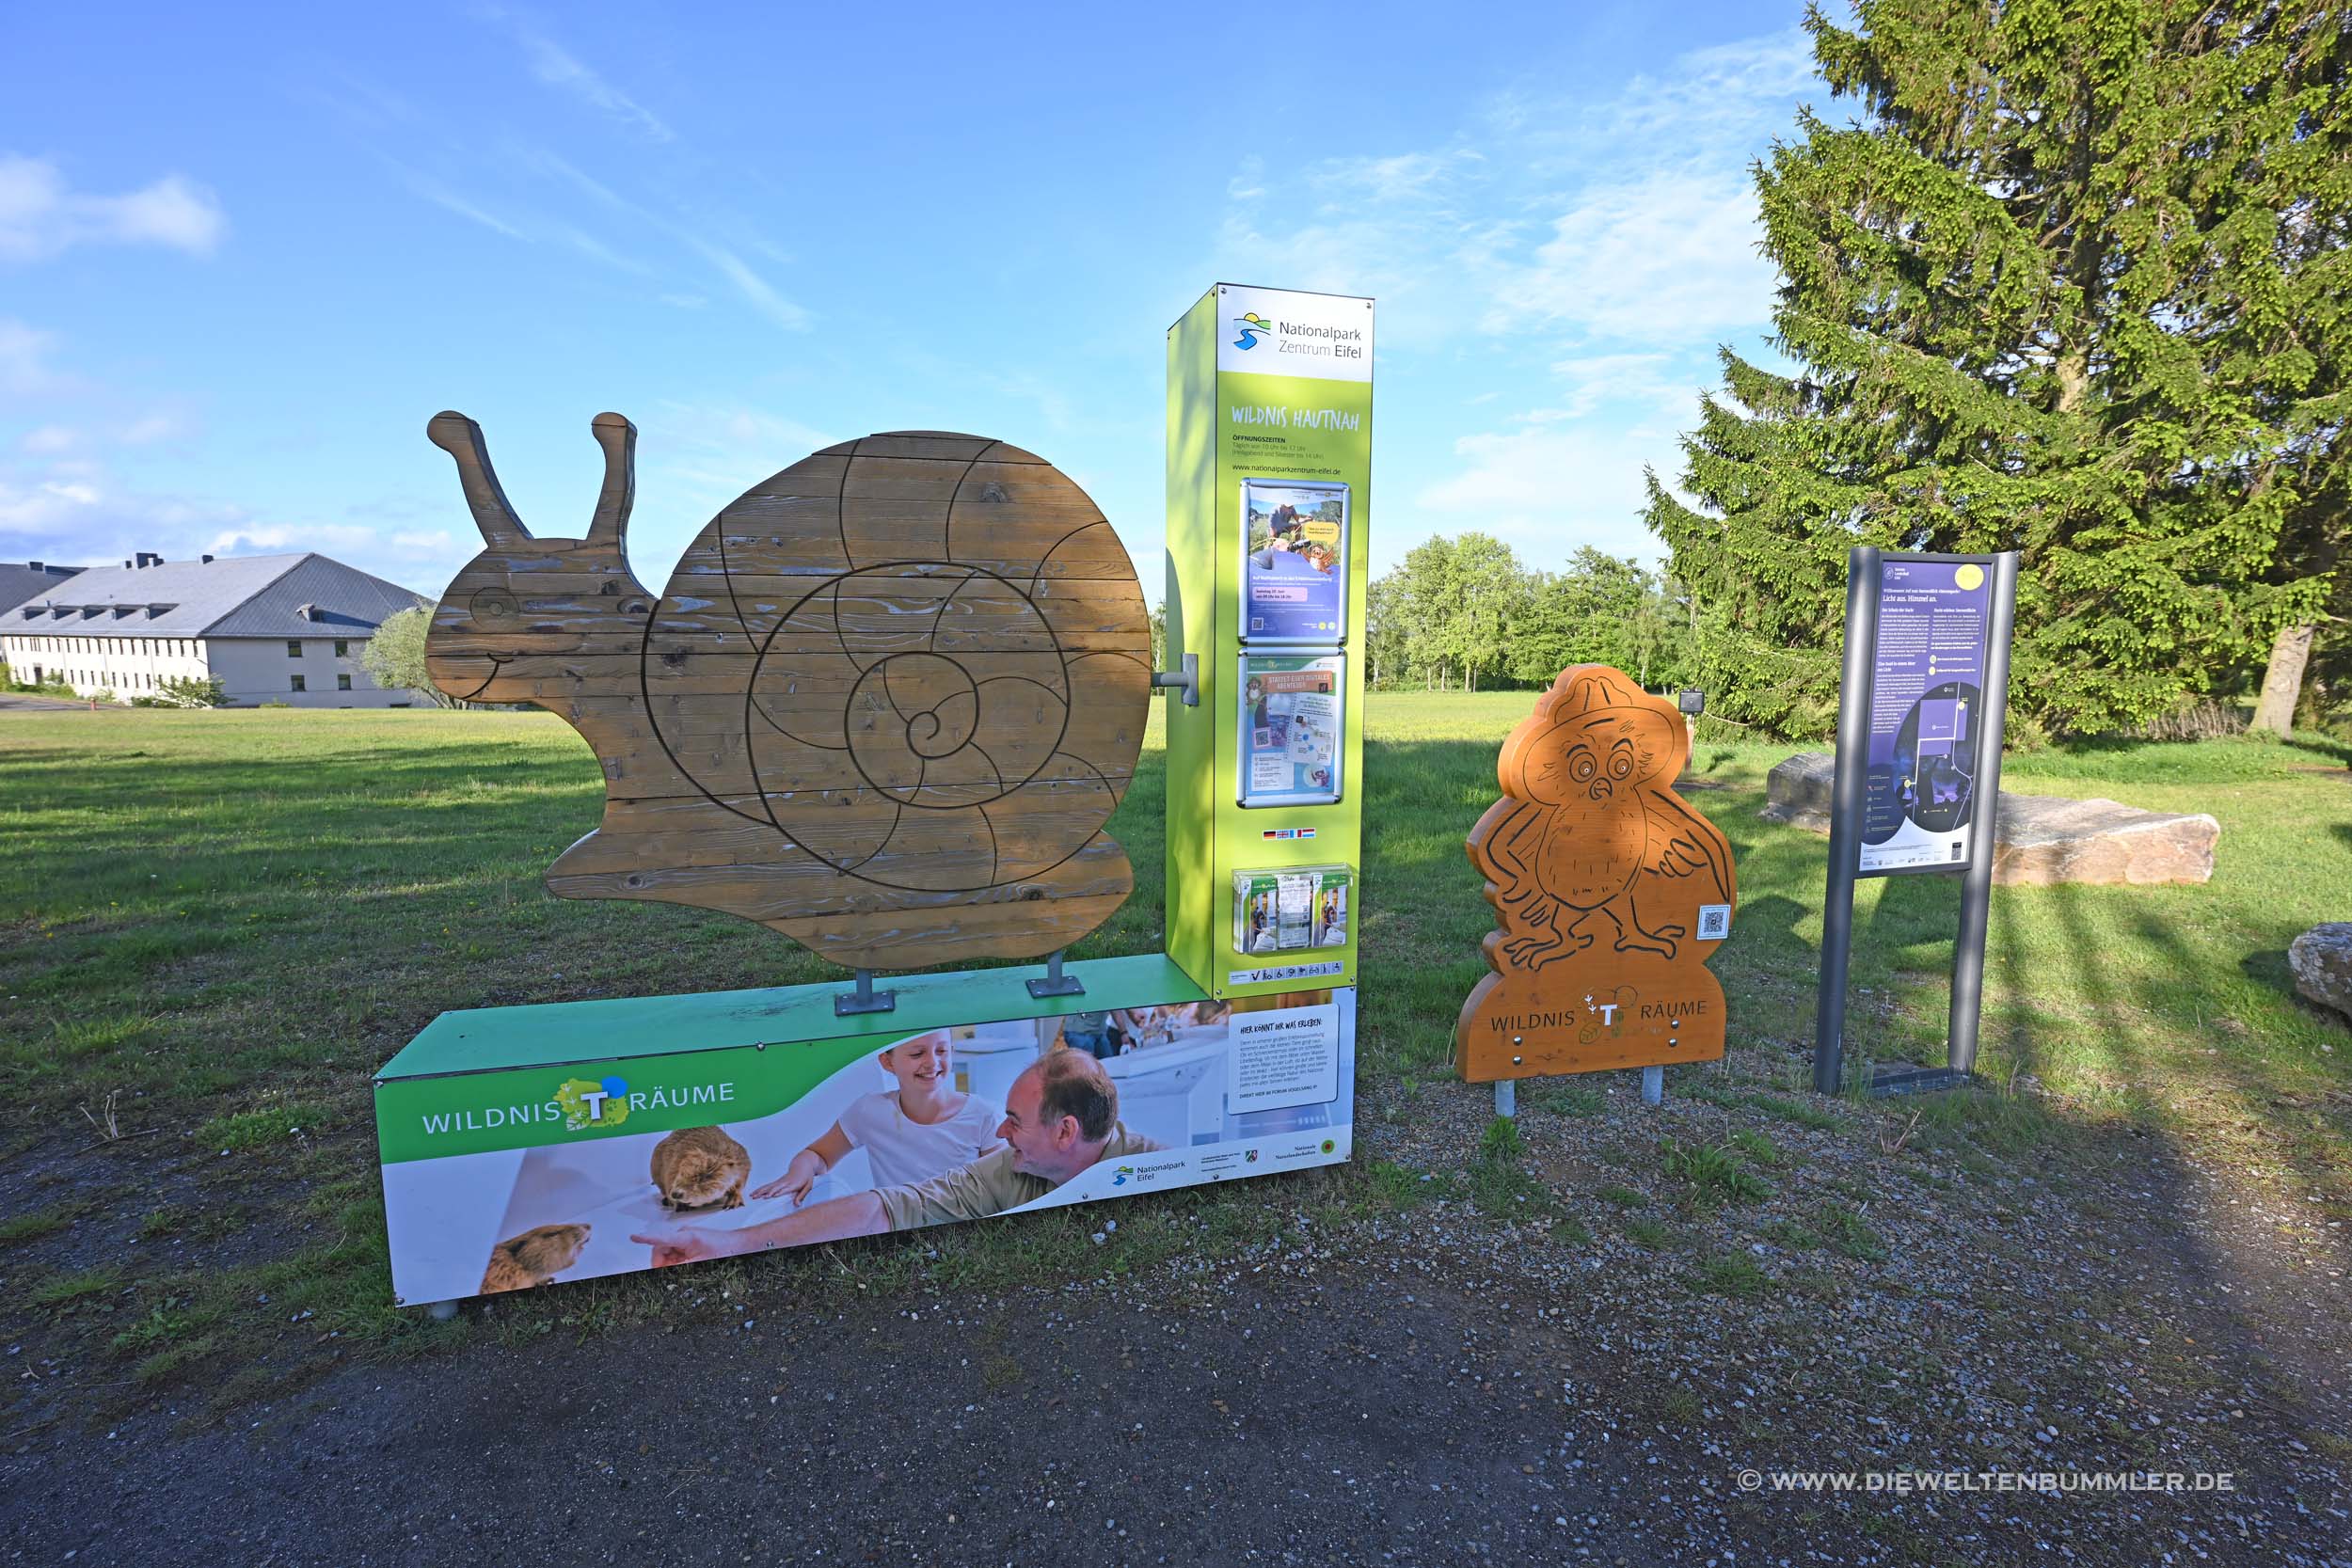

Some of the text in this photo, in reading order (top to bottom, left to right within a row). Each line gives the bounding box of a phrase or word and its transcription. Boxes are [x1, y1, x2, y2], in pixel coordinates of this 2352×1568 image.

[1280, 322, 1361, 342] Nationalpark
[1279, 340, 1361, 358] Zentrum Eifel
[1232, 405, 1359, 432] WILDNIS HAUTNAH
[1232, 435, 1286, 443] ÖFFNUNGSZEITEN
[1232, 465, 1341, 475] www.nationalparkzentrum-eifel.de
[1491, 1010, 1575, 1032] WILDNIS
[1641, 1000, 1708, 1021] RÄUME
[1241, 1026, 1253, 1035] HIER
[1254, 1023, 1274, 1033] KÖNNT
[1286, 1020, 1296, 1029] WAS
[421, 1101, 562, 1134] WILDNIS
[629, 1083, 736, 1112] RÄUME
[1137, 1161, 1185, 1174] Nationalpark
[1137, 1173, 1154, 1182] Eifel
